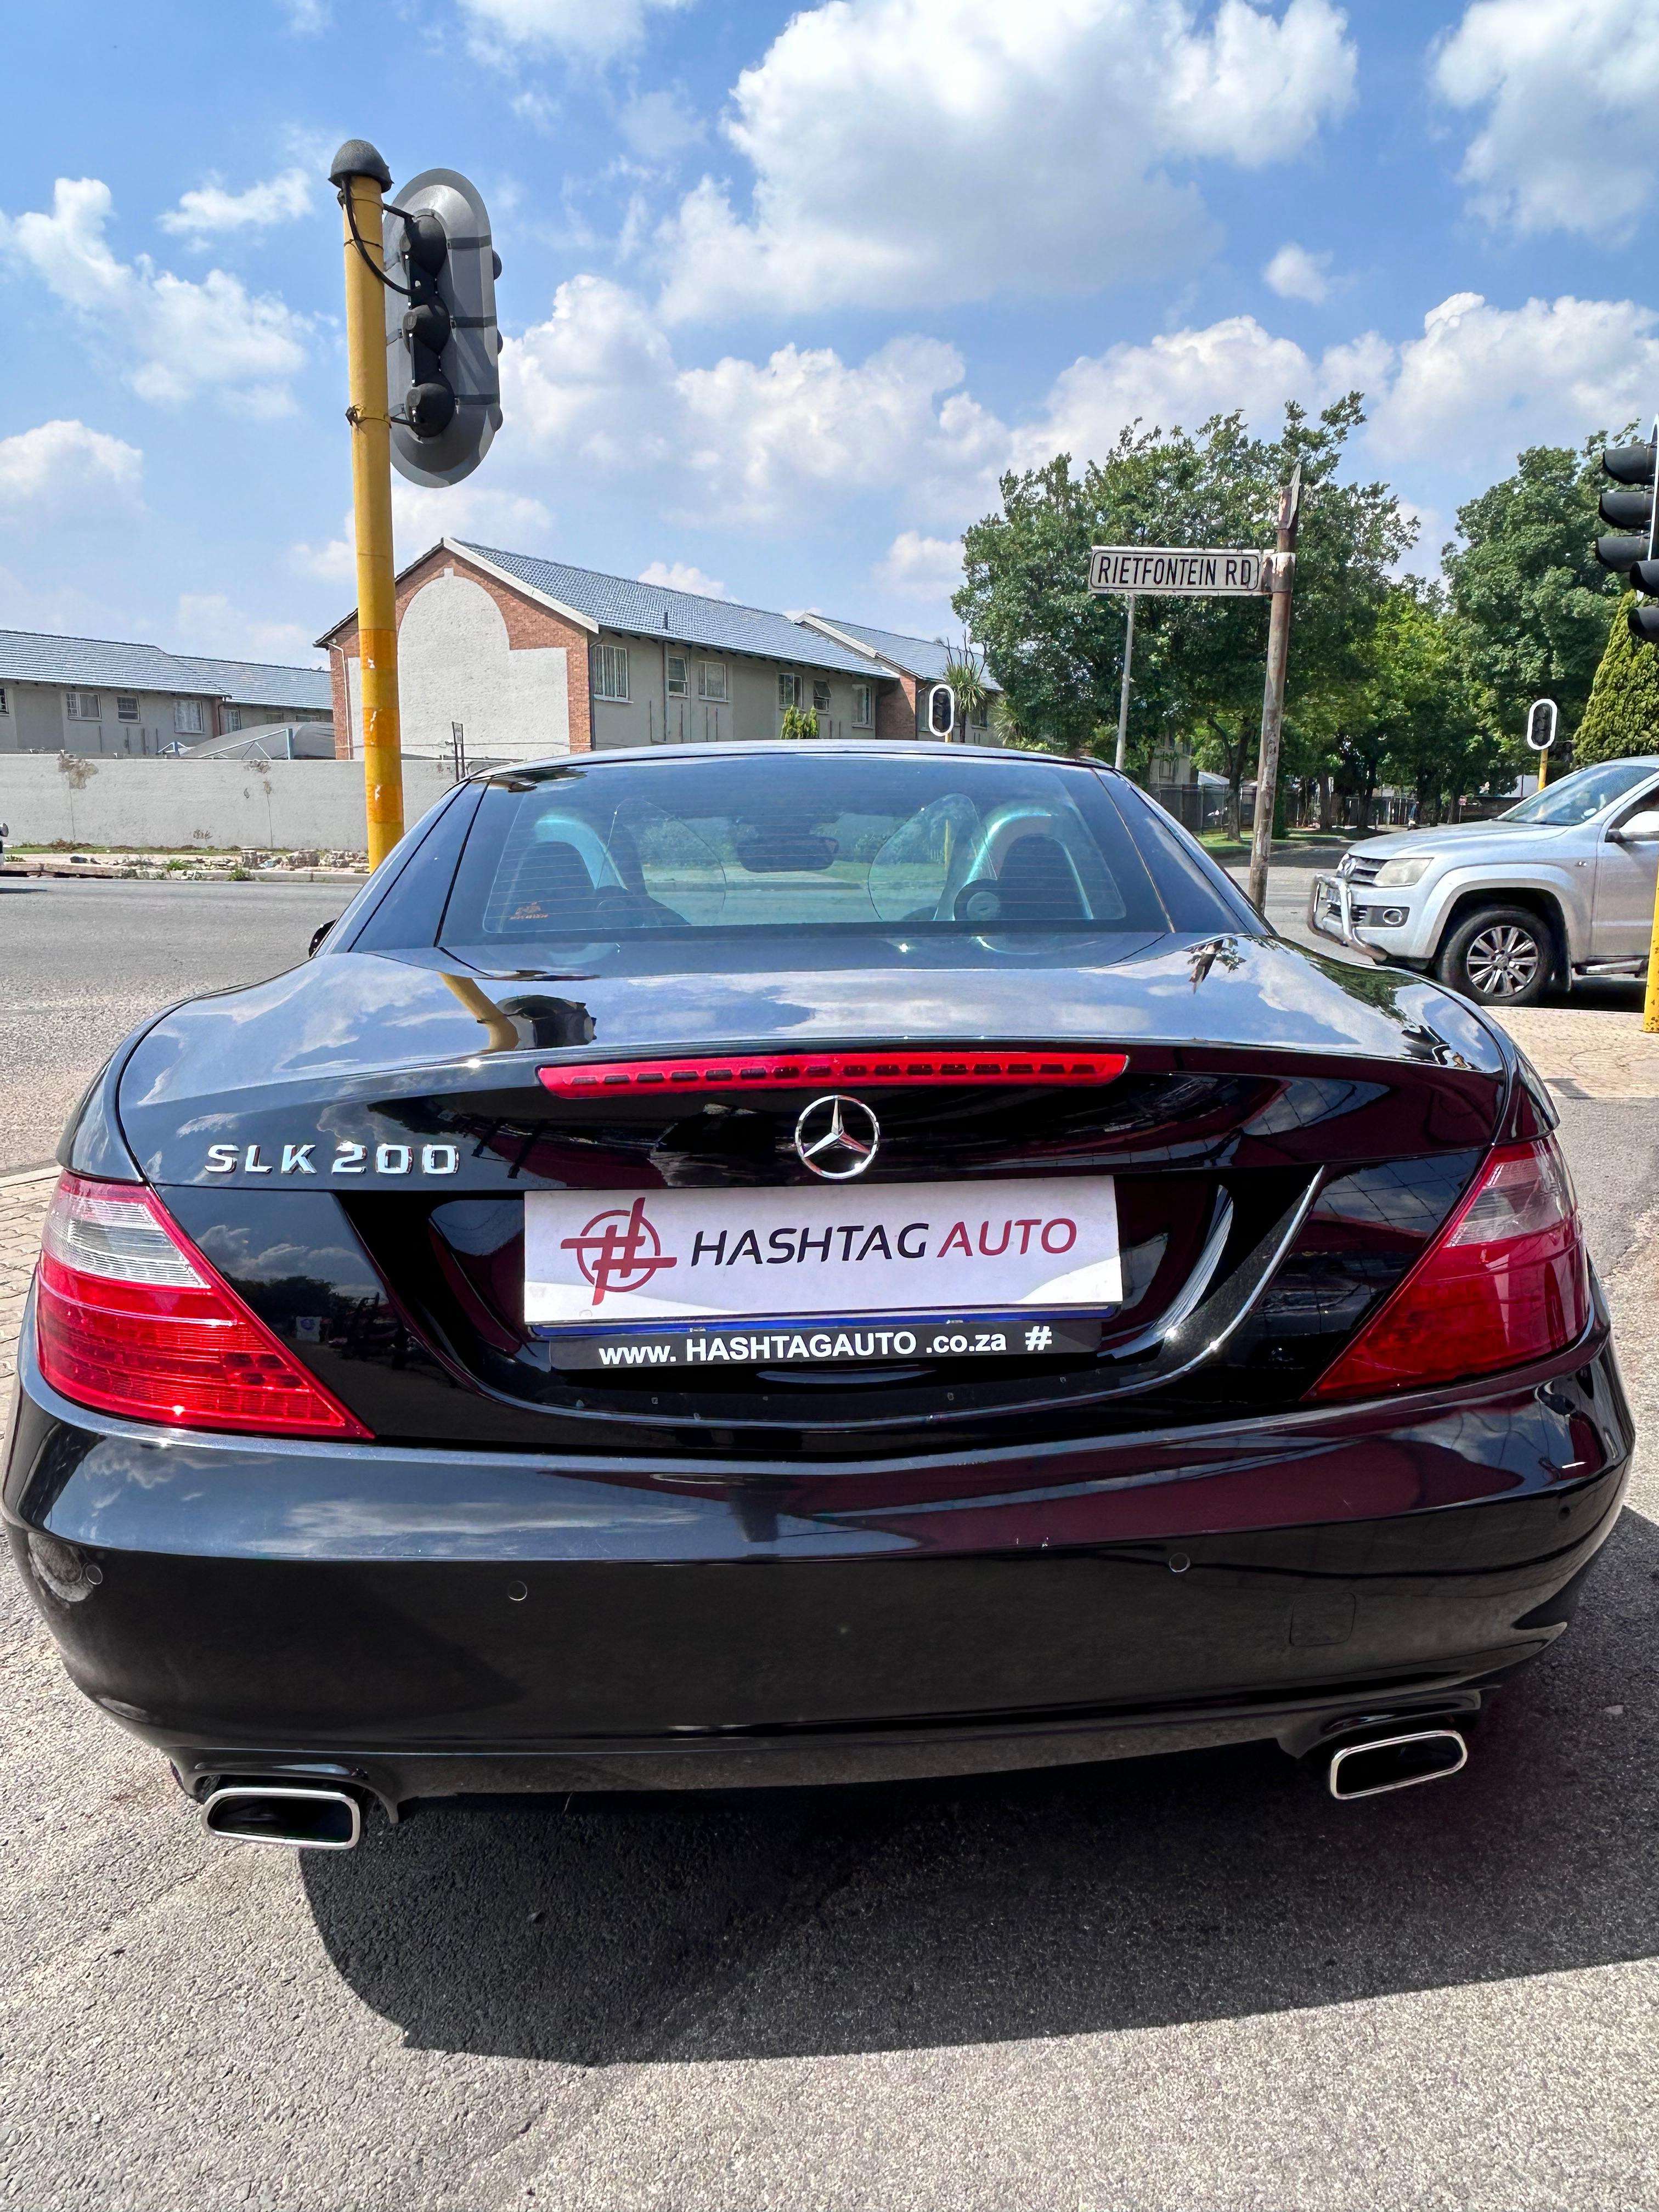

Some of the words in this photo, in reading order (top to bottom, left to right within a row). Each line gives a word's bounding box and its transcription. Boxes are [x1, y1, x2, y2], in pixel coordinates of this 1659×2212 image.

[1097, 556, 1217, 586] RIETFONTEIN
[1225, 558, 1252, 587] RD
[204, 1143, 318, 1175] SLK
[331, 1140, 461, 1175] 200
[690, 1222, 930, 1268] HASHTAG
[936, 1217, 1077, 1259] AUTO
[686, 1330, 917, 1362] HASHTAGAUTO
